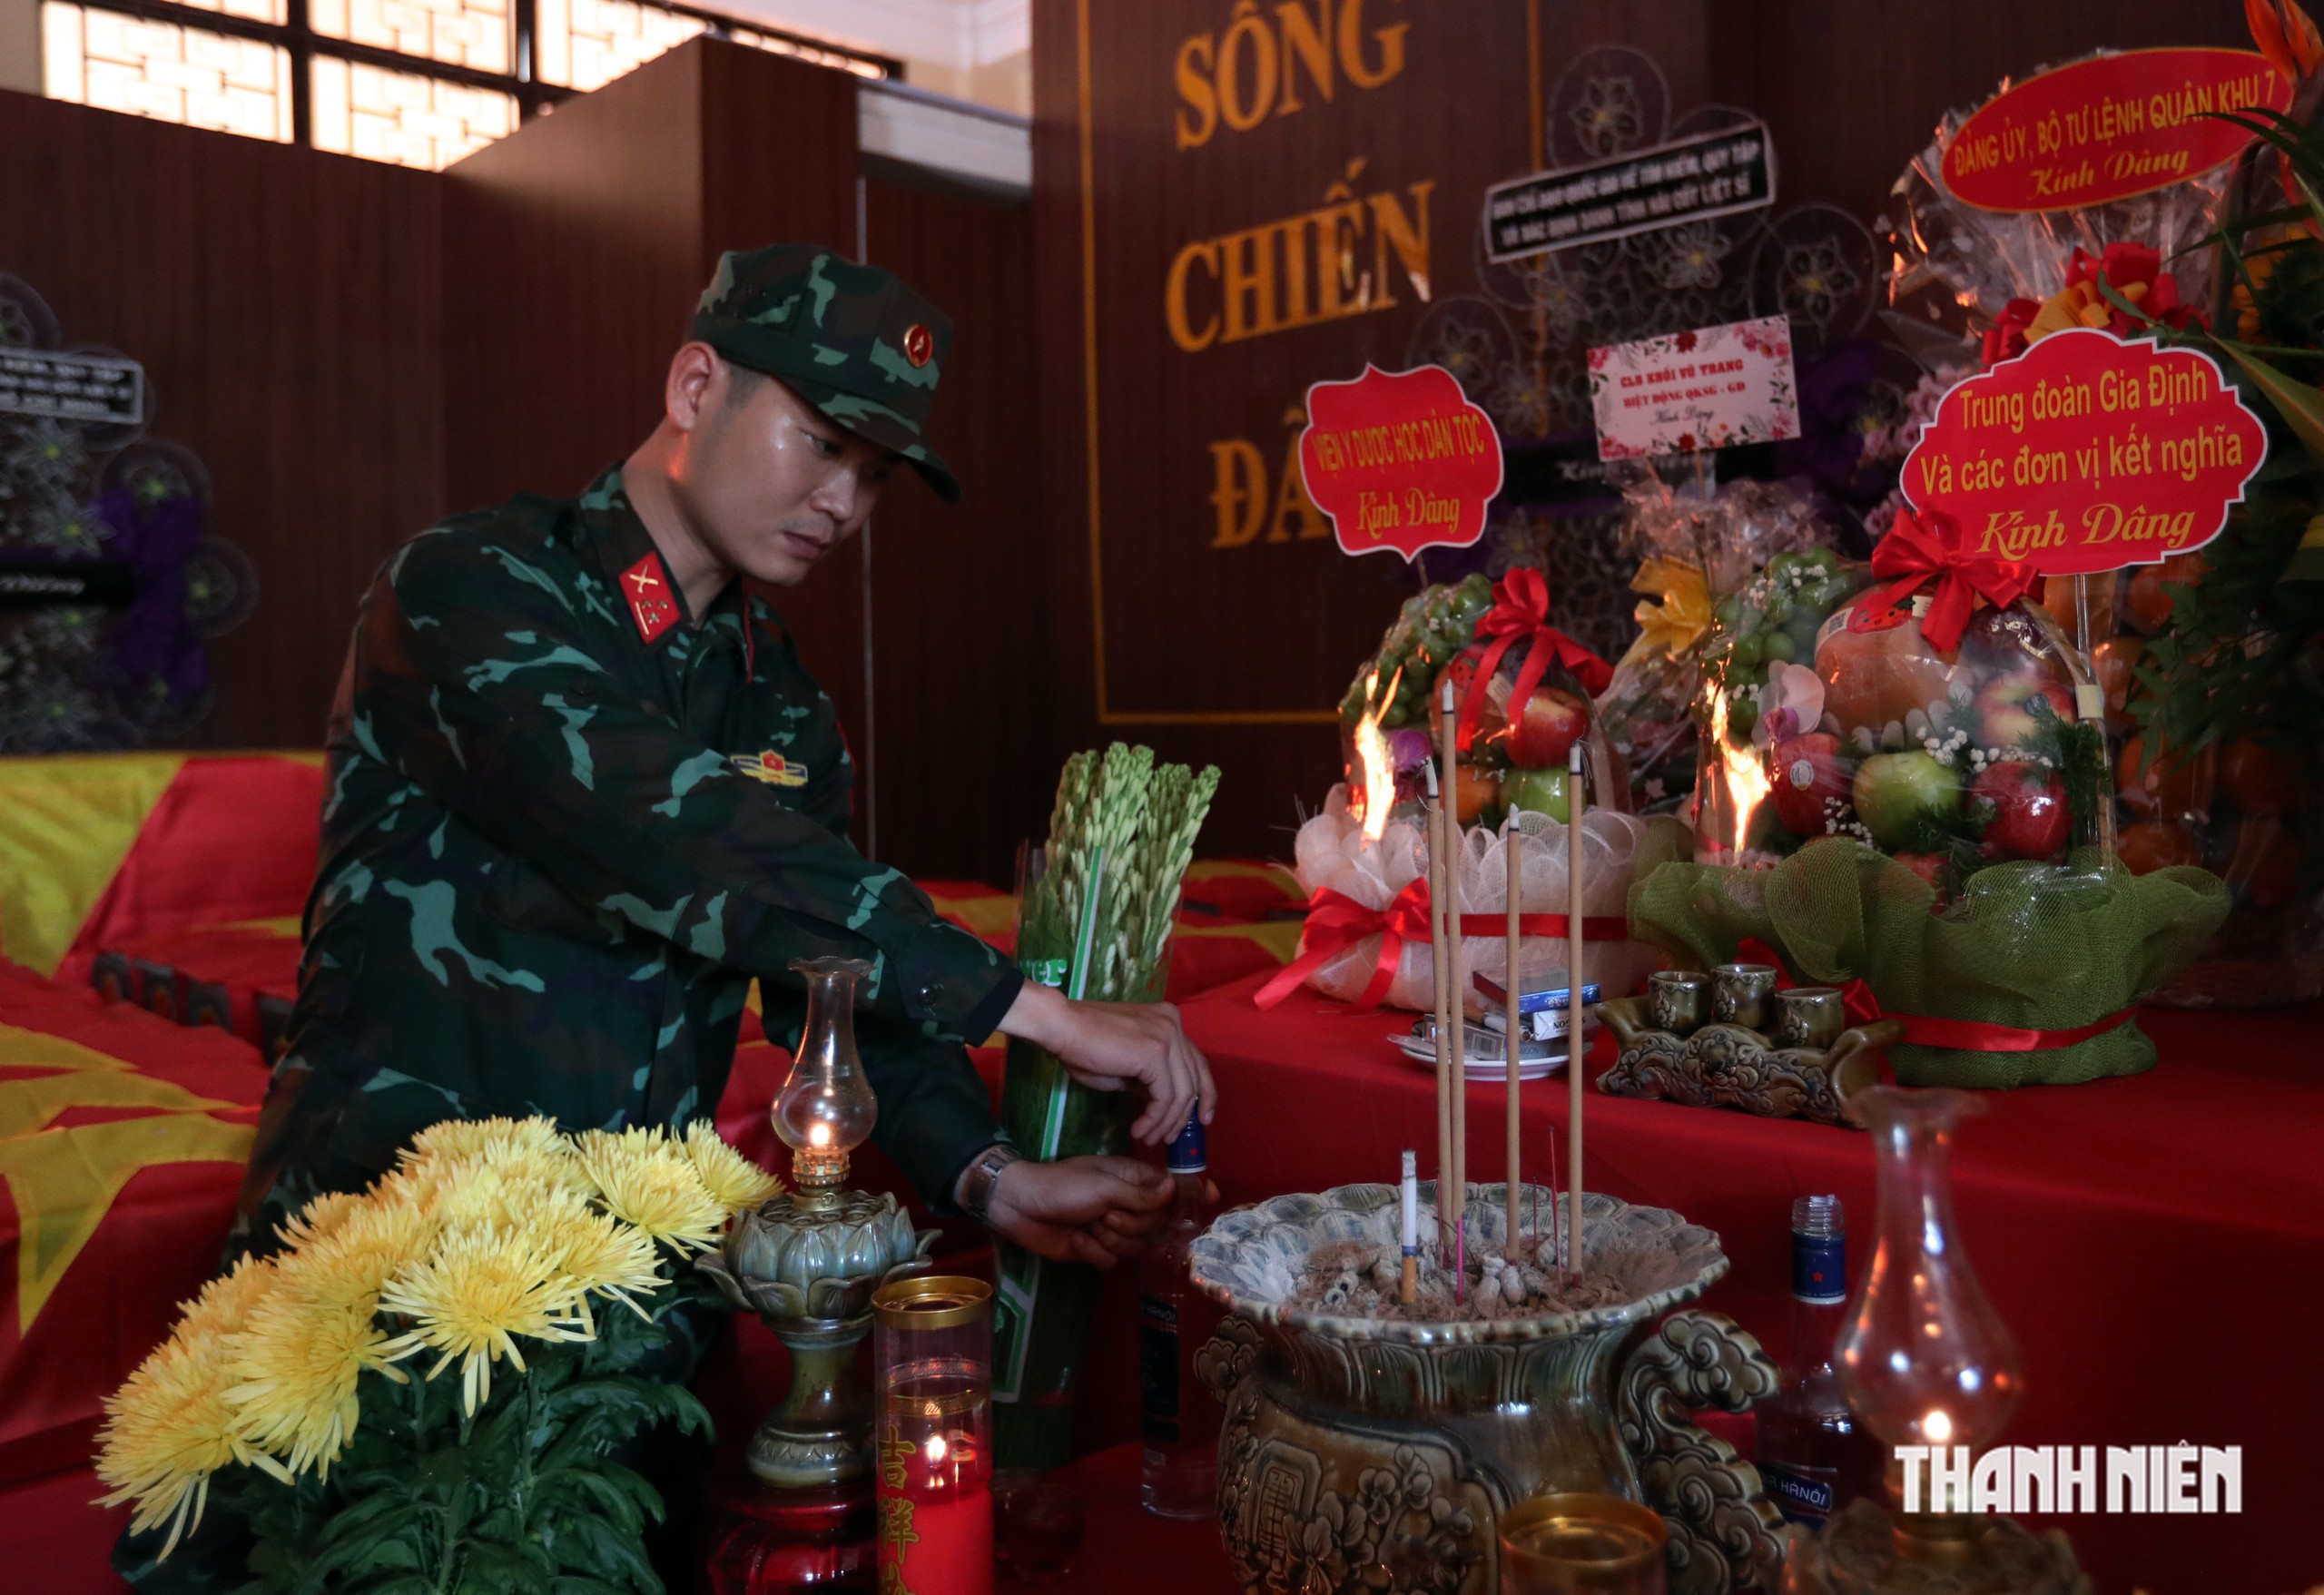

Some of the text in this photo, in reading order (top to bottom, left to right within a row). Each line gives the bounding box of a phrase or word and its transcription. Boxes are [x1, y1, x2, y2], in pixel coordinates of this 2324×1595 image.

[1175, 0, 1411, 151] SÔNG
[1954, 127, 2000, 178] ĐẢNG
[2037, 109, 2062, 158] BỘ
[2066, 103, 2090, 147] TƯ
[2093, 95, 2145, 148] LỆNH
[2149, 80, 2212, 130] QUÂN
[2218, 73, 2260, 114] KHU
[2264, 69, 2277, 105] 7
[2105, 149, 2191, 181] Dâng
[1166, 157, 1435, 352] CHIẾN
[1620, 374, 1643, 389] CLB
[1699, 359, 1744, 376] TRANG
[1960, 360, 2208, 434] Trung đoàn Gia Định
[1393, 420, 1424, 472] HỌC
[1452, 409, 1485, 466] TỘC
[1920, 422, 2243, 496] Và các đơn vị kết nghĩa
[1357, 487, 1461, 540] Kính Dâng
[1974, 503, 2196, 561] Kính Dâng
